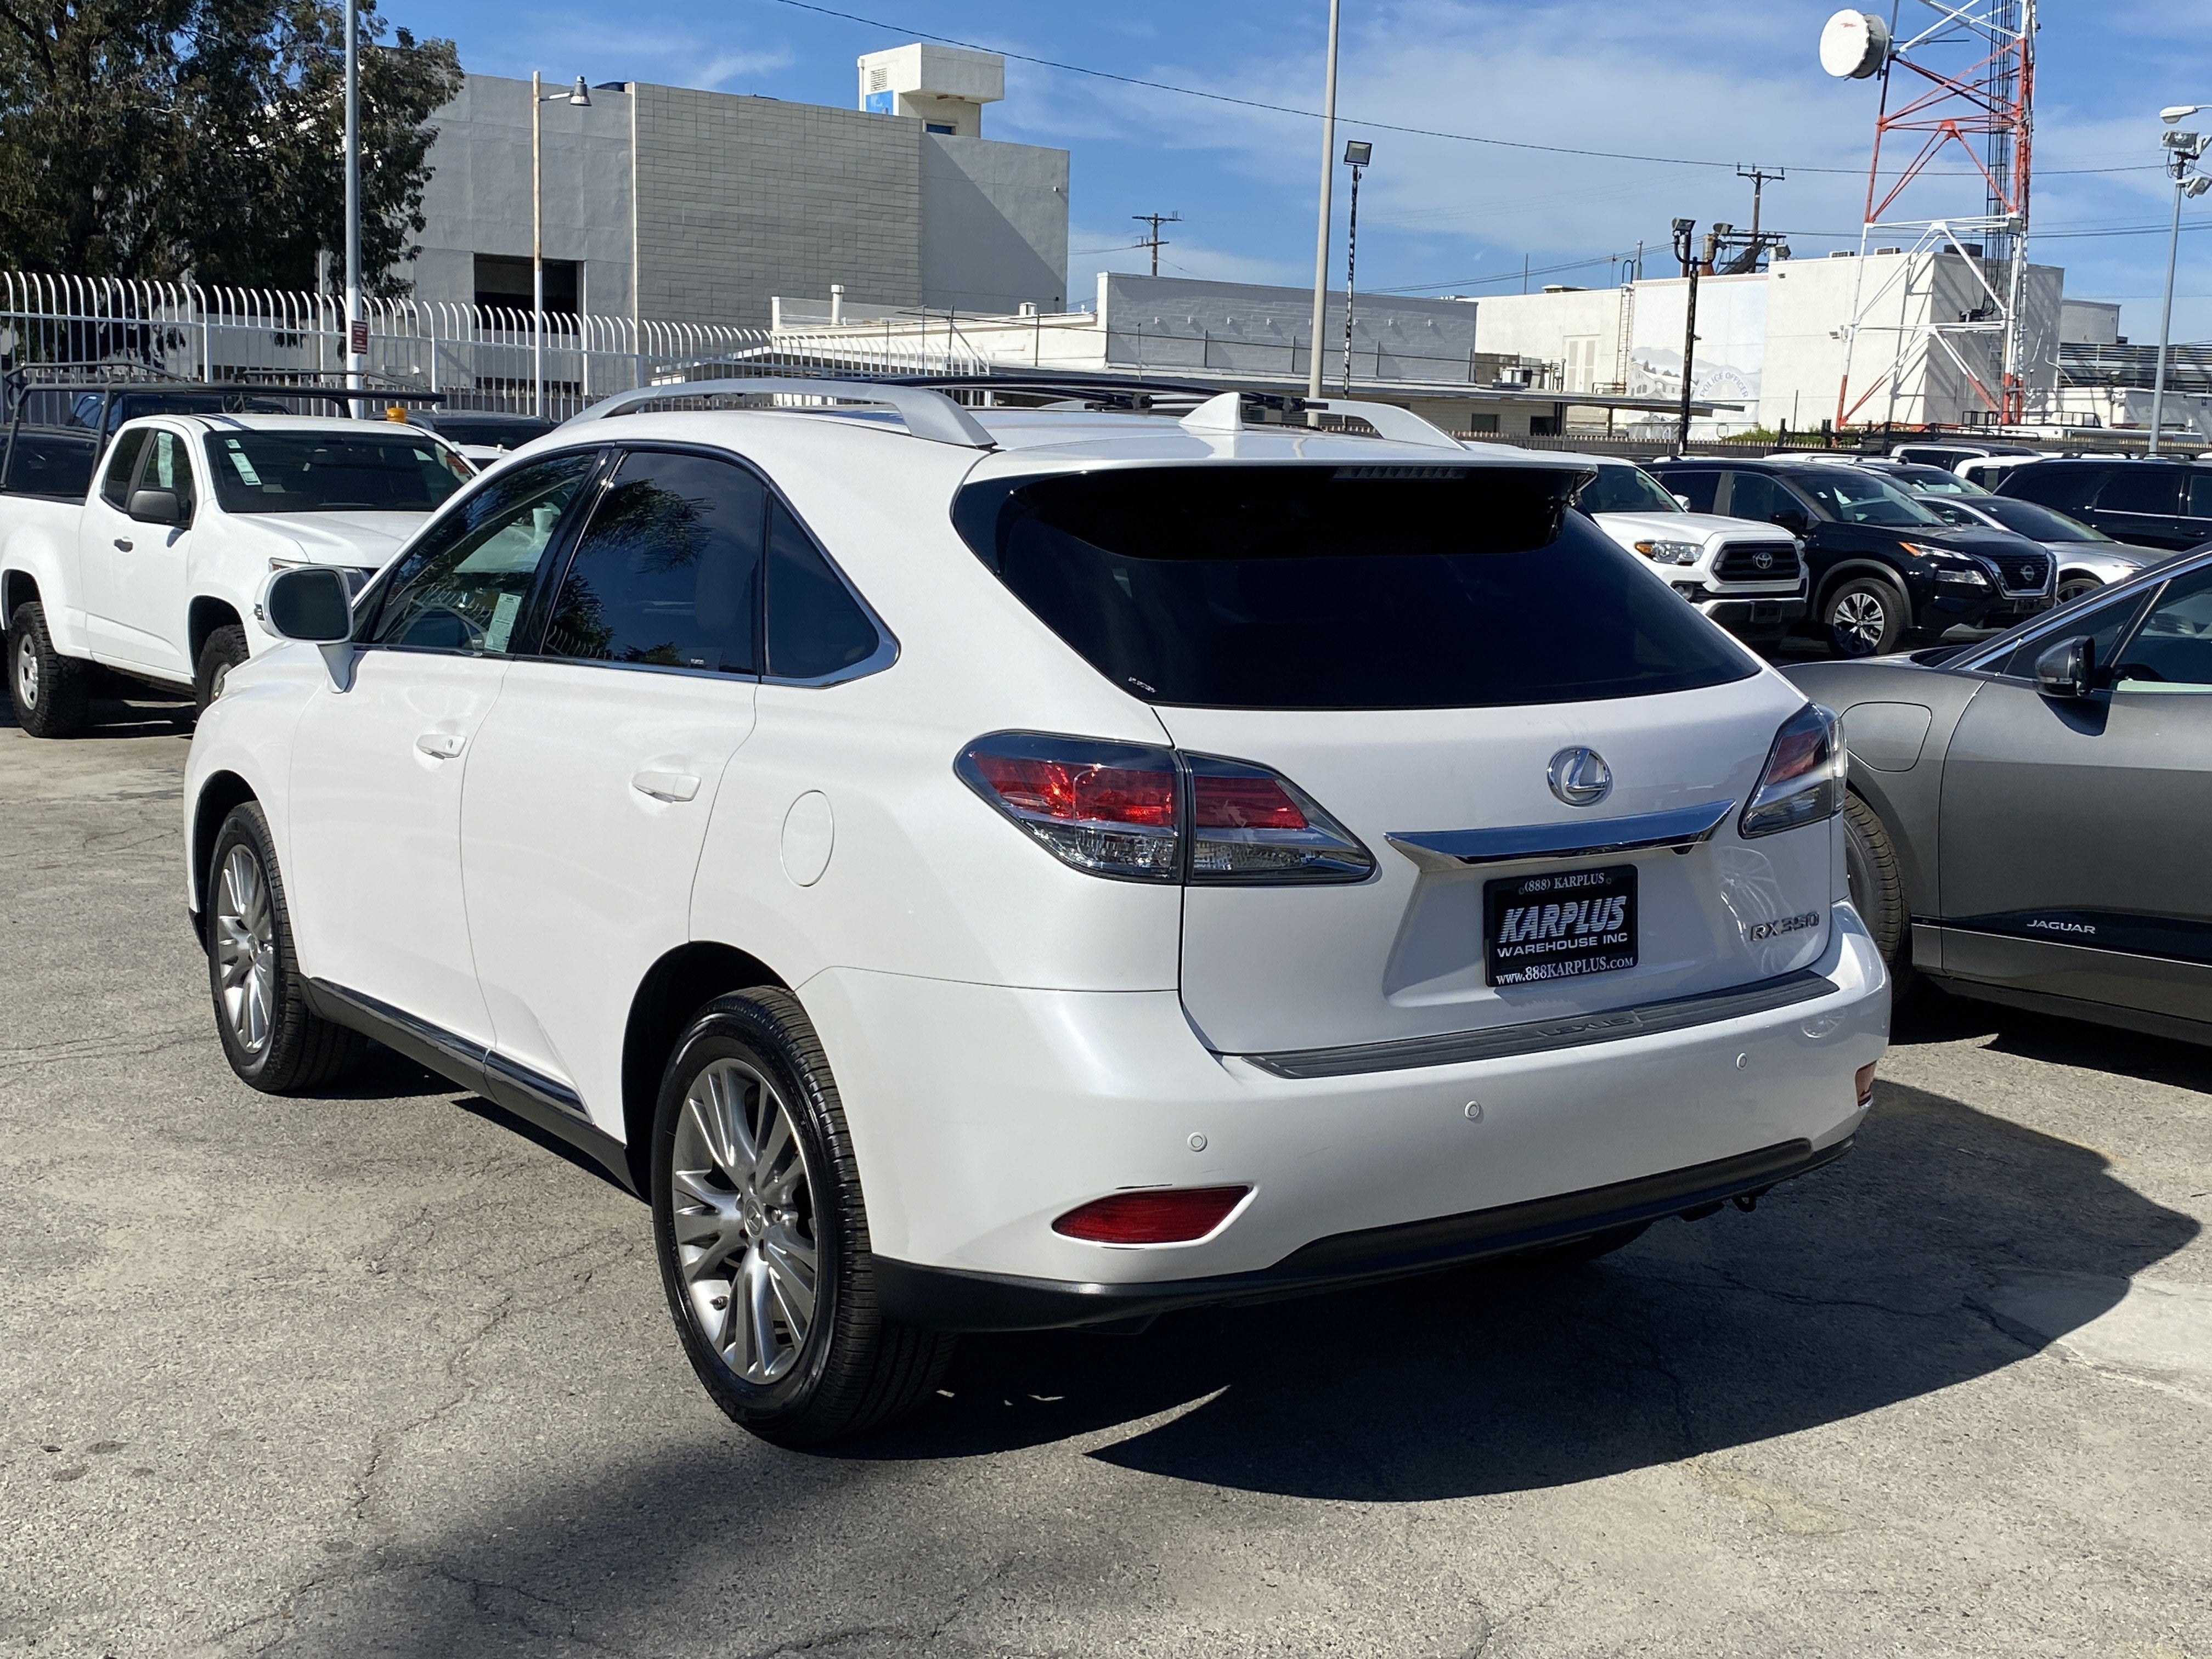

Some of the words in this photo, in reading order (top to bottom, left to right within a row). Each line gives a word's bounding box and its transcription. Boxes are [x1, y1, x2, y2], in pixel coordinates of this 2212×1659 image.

[1700, 373, 1723, 397] POLICE
[1725, 372, 1748, 398] OFFICER
[1524, 879, 1550, 893] (888)
[1554, 872, 1605, 889] KARPLUS
[1498, 896, 1627, 943] KARPLUS
[2026, 919, 2096, 934] JAGUAR
[1497, 936, 1598, 958] WAREHOUSE
[1603, 933, 1628, 945] INC
